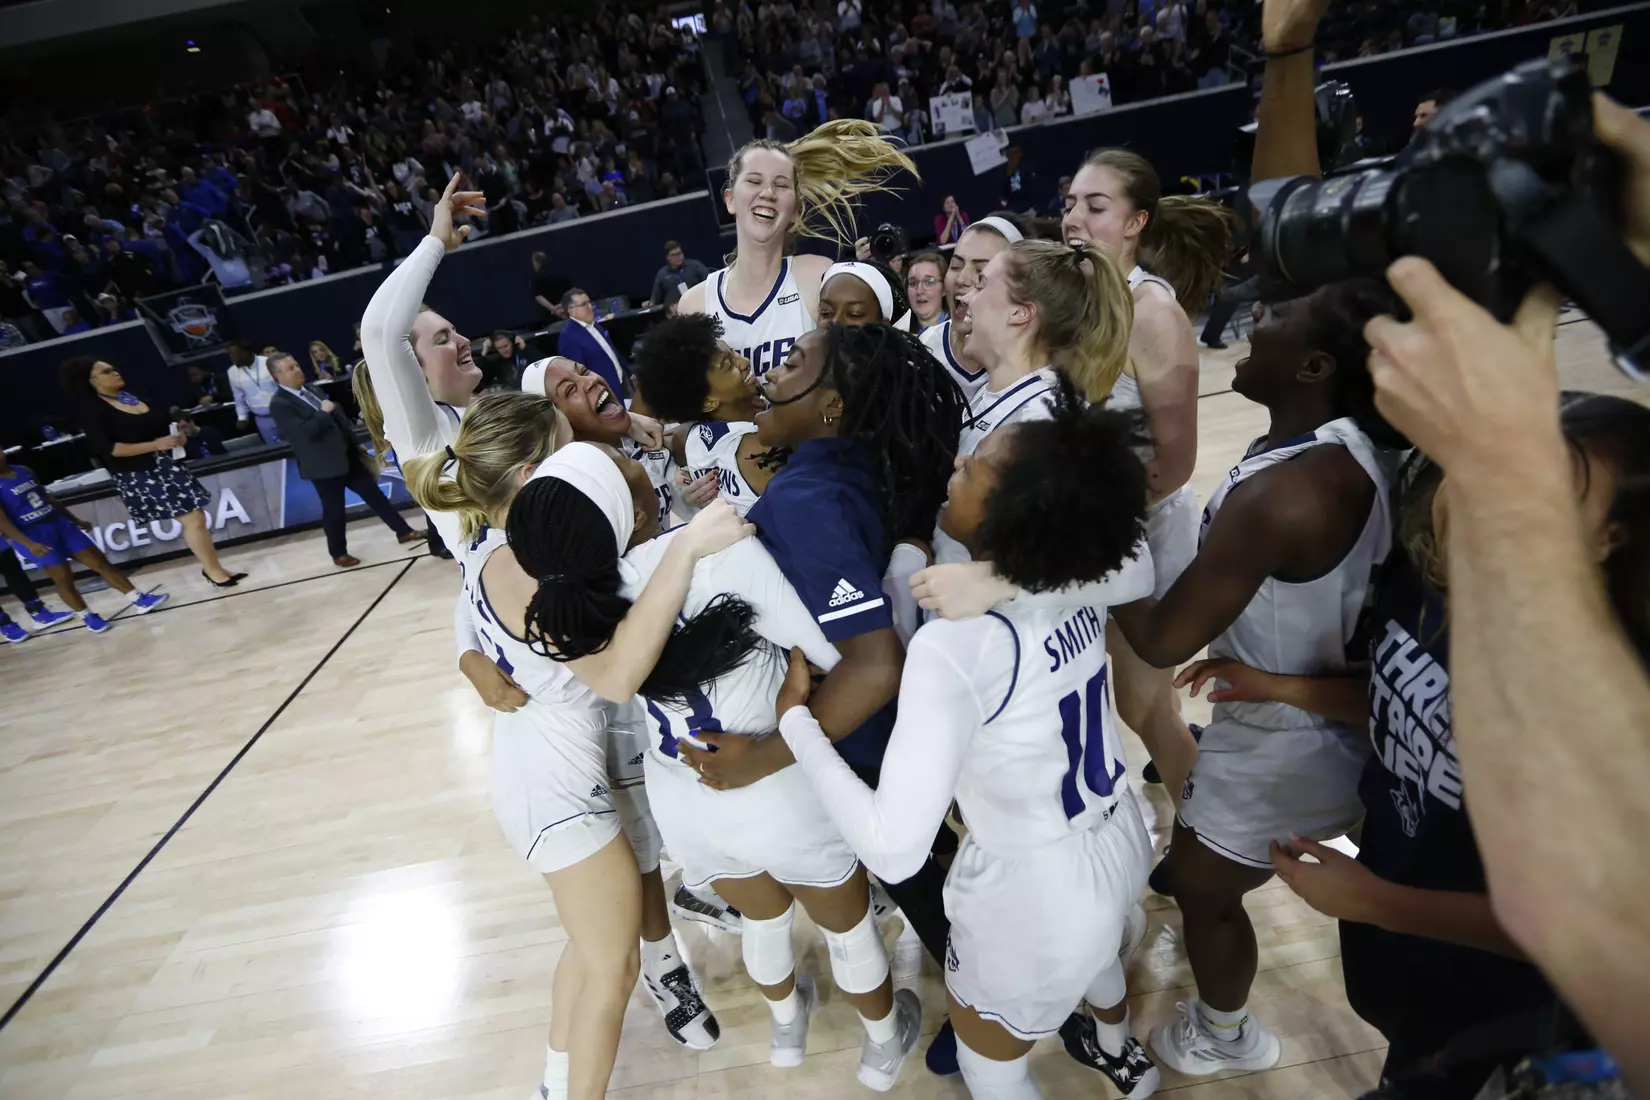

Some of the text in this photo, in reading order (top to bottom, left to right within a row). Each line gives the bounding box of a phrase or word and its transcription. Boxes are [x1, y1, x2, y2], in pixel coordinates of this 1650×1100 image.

[27, 491, 43, 508] 2
[828, 590, 865, 607] adidas
[1043, 606, 1101, 673] SMITH
[1058, 662, 1126, 821] 10
